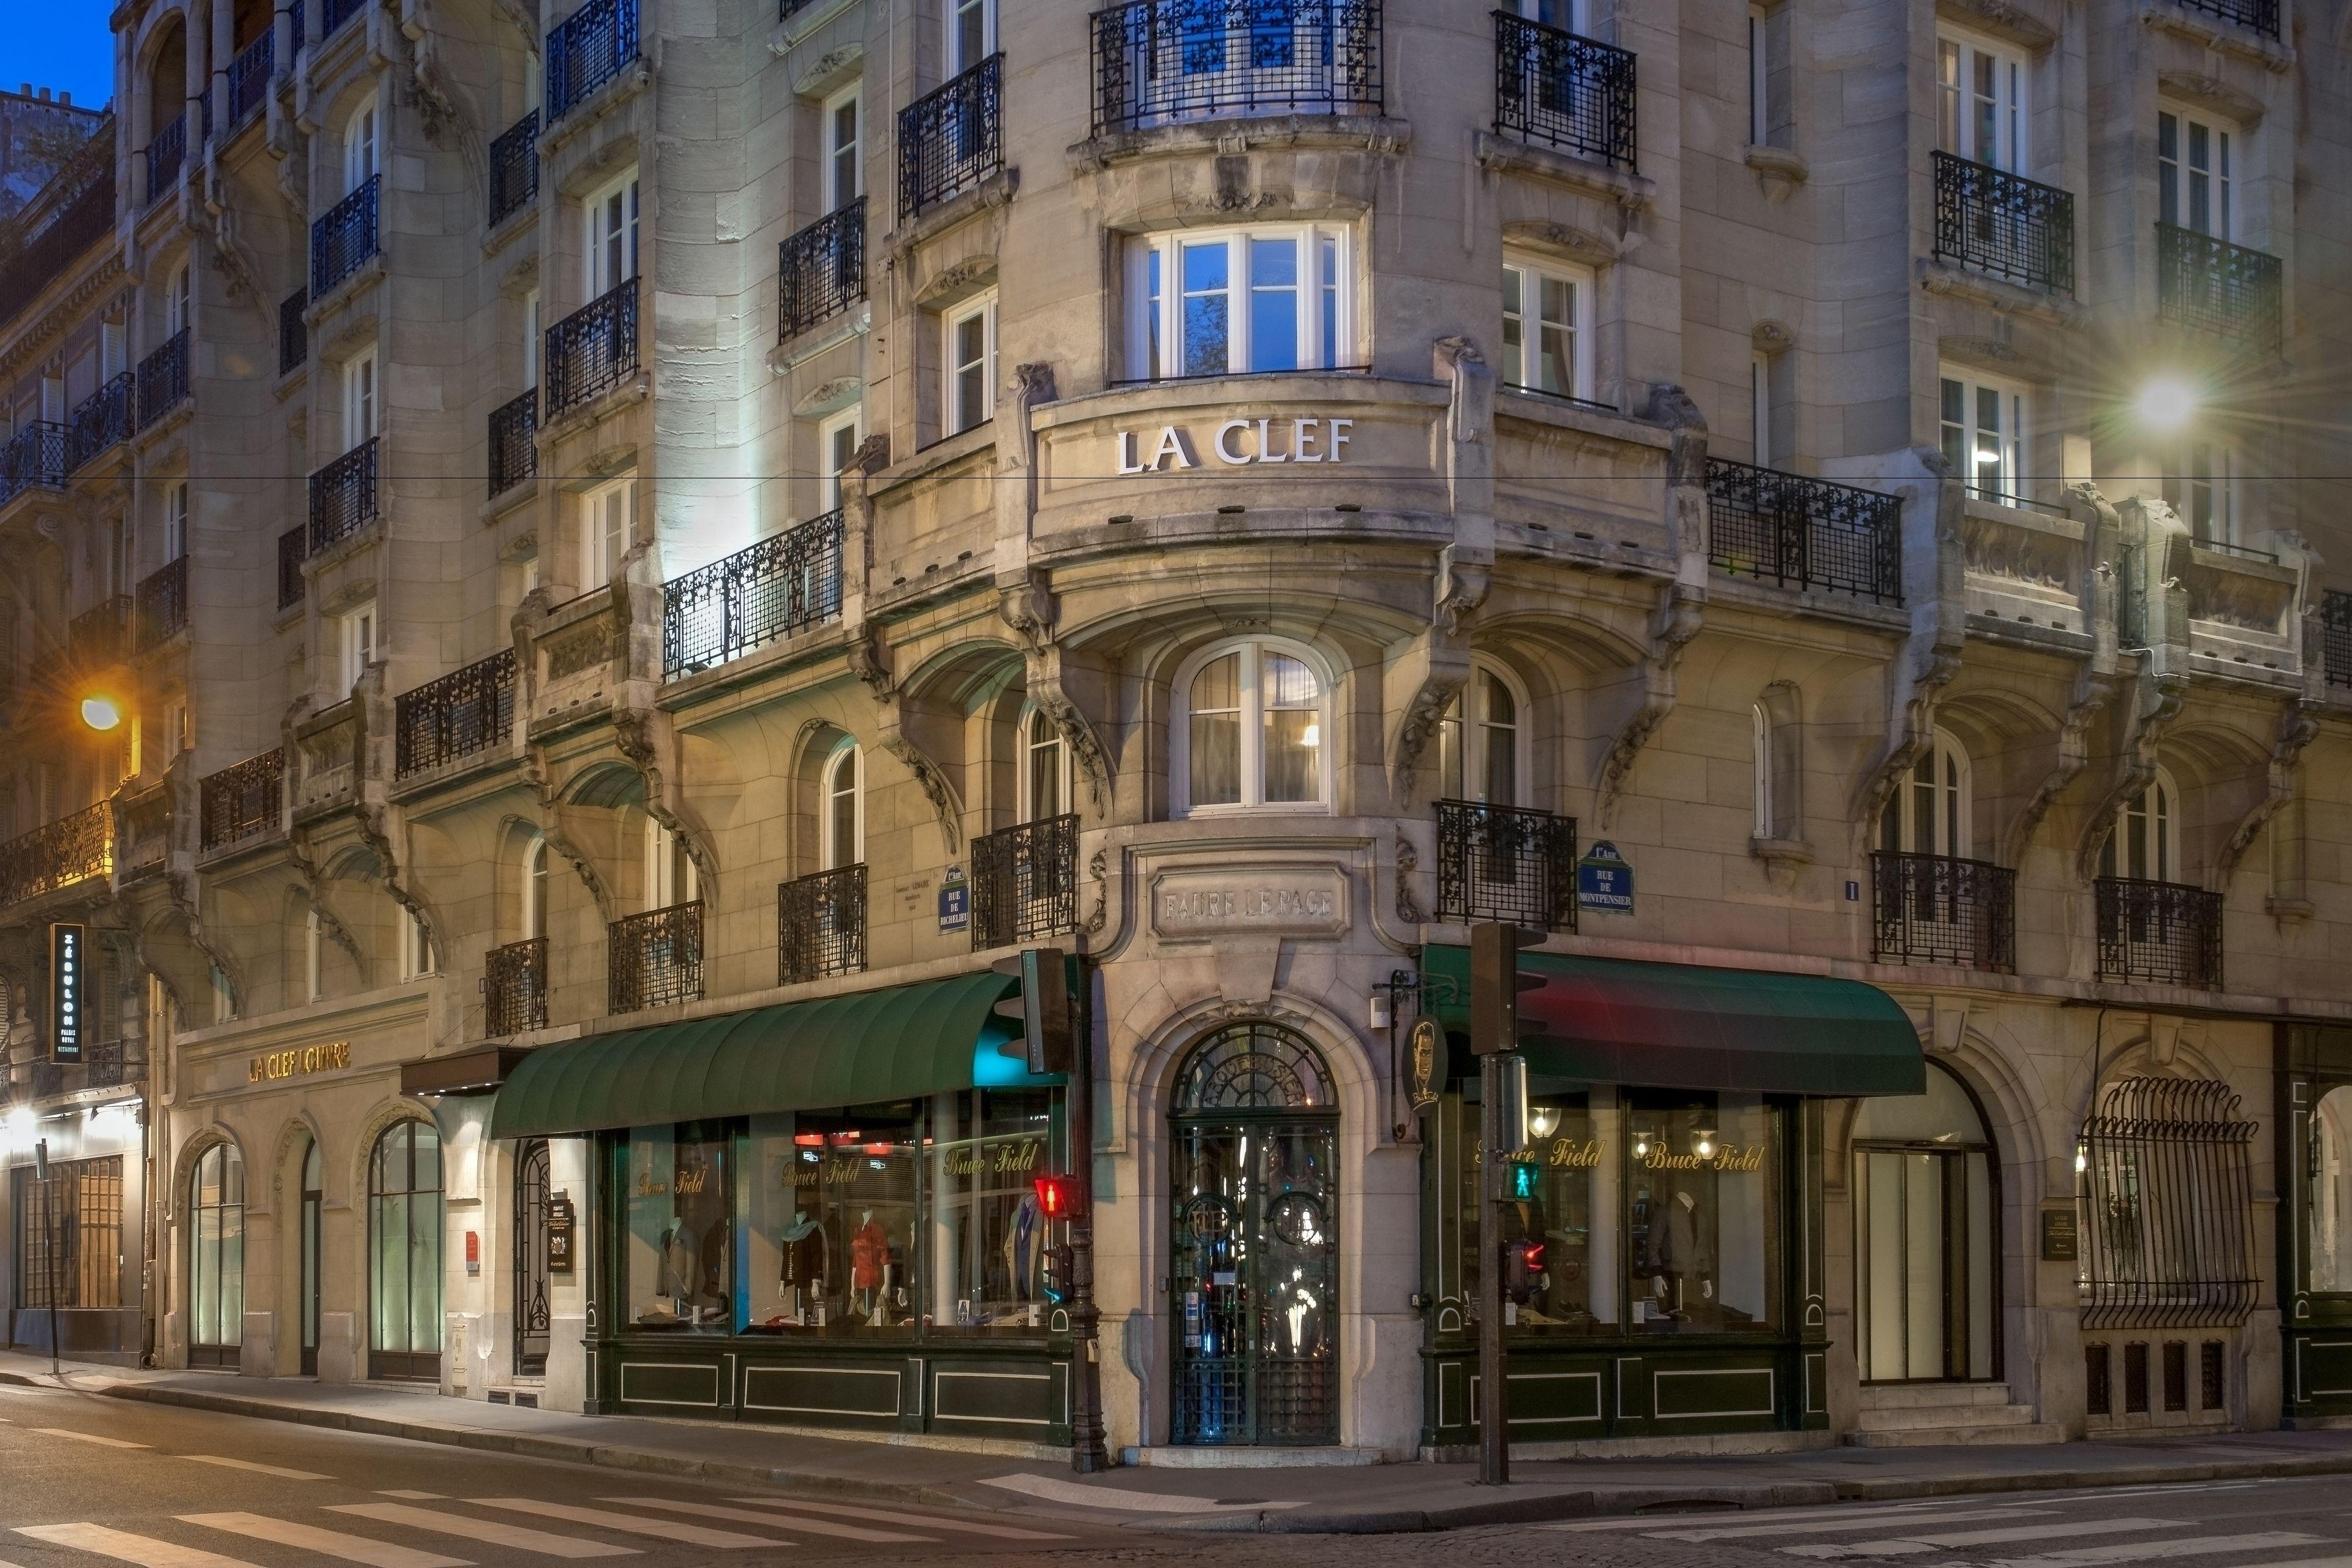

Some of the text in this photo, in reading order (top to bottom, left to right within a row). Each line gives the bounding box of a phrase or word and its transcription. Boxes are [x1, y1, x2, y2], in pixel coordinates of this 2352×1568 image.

[1118, 418, 1353, 475] LA CLEF
[1597, 870, 1613, 880] RUE
[1600, 883, 1611, 892] DE
[948, 891, 960, 901] RUE
[951, 903, 959, 913] DE
[1165, 889, 1334, 919] FAURE LE PAGE
[1580, 892, 1631, 905] MONTPENSIER
[940, 912, 968, 925] RICHELIEU
[250, 1041, 352, 1082] LA CLEF LOUVRE
[943, 1144, 1038, 1176] Bruce Field
[1550, 1138, 1607, 1166] Field
[1645, 1141, 1766, 1171] Bruce Field
[638, 1170, 706, 1196] Bruce Field
[781, 1158, 862, 1187] Bruce Field
